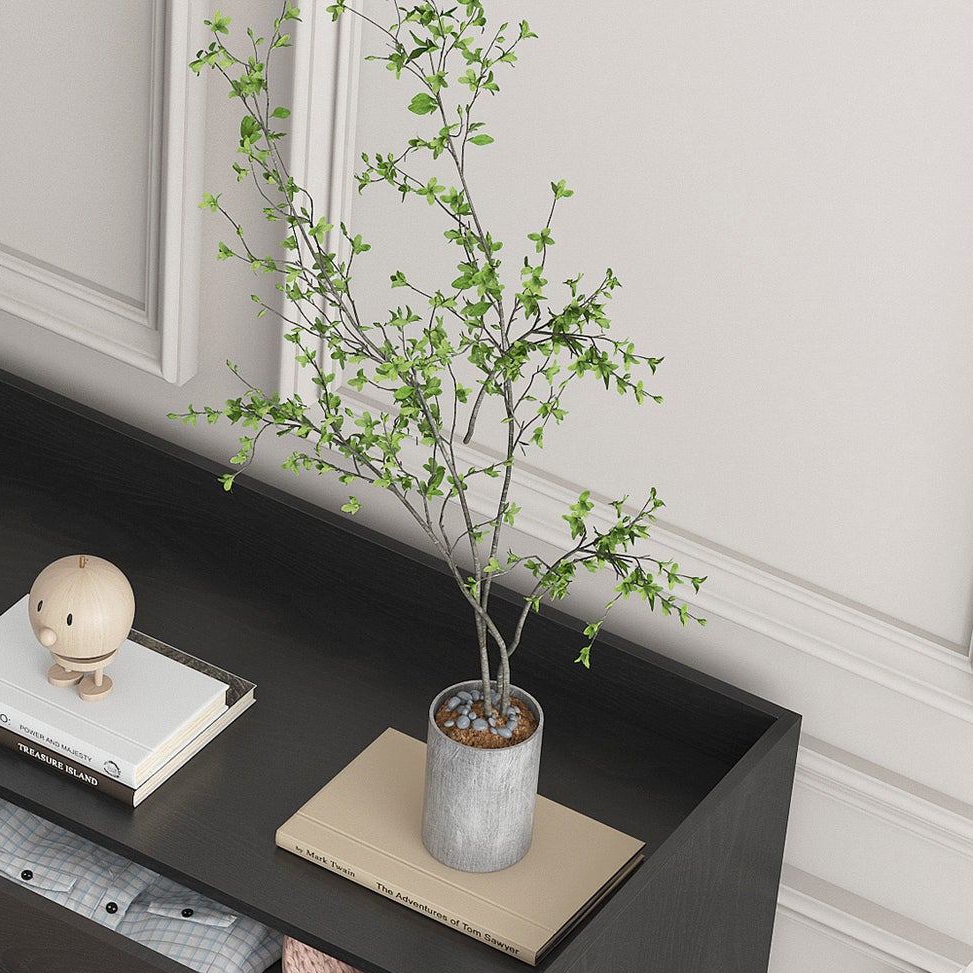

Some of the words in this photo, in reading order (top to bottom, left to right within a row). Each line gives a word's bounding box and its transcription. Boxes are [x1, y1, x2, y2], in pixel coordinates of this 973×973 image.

[17, 742, 65, 771] TREASURE
[65, 763, 99, 787] ISLAND
[19, 724, 45, 741] POWER
[45, 737, 60, 748] AND
[61, 744, 93, 763] MAJESTY
[295, 845, 304, 854] by
[306, 849, 328, 865] Mark
[330, 860, 356, 878] Twain
[376, 881, 394, 896] The
[395, 892, 448, 922] Adventures
[450, 918, 460, 928] of
[462, 922, 482, 938] Tom
[484, 933, 520, 956] Sawyer
